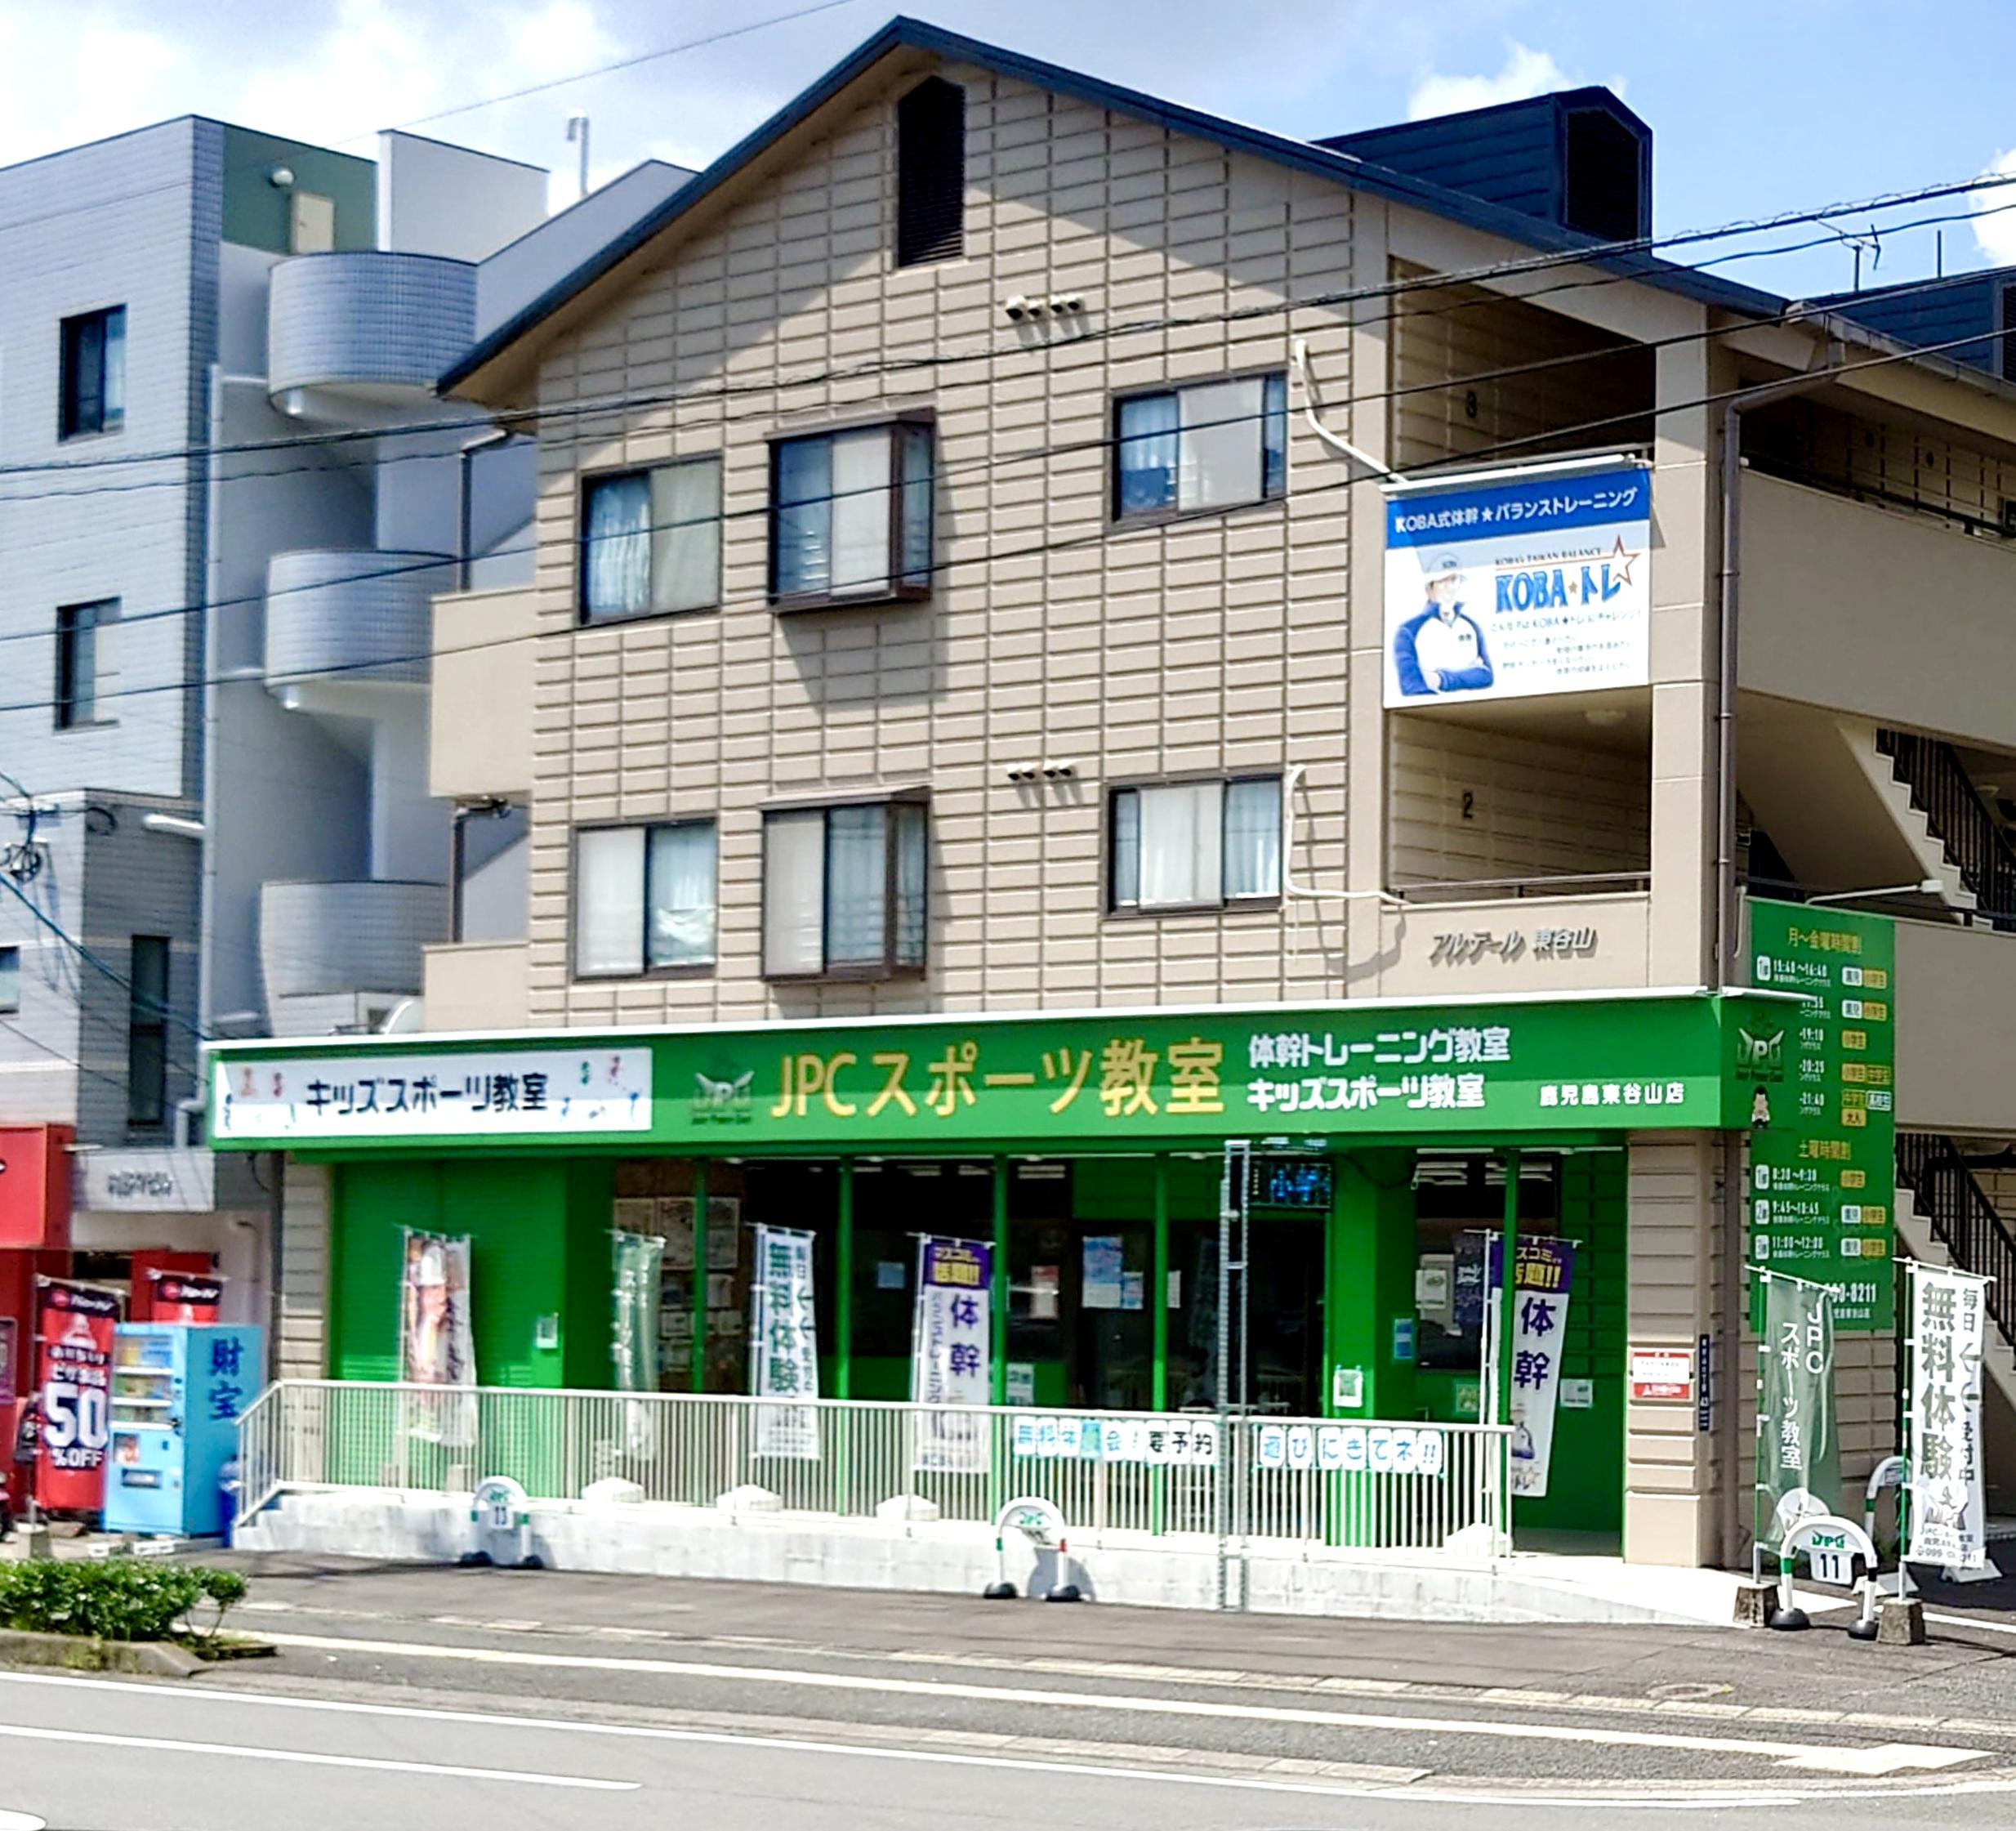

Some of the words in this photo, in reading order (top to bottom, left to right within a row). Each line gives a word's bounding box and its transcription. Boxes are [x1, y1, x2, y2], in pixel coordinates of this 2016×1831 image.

[1462, 791, 1473, 819] 2
[1249, 1027, 1510, 1069] 体幹トレーニング教室
[306, 1072, 548, 1116] キッズスポーツ教室
[771, 1036, 1224, 1118] JPCスポーツ教室
[1247, 1074, 1485, 1113] キッズスポーツ教室
[1540, 1082, 1684, 1107] 鹿児島東谷山店
[949, 1293, 982, 1379] 体幹
[1514, 1288, 1556, 1390] 体幹
[1806, 1302, 1823, 1374] JPC
[209, 1337, 244, 1420] 財宝
[1780, 1323, 1803, 1470] スポーツ教室
[1921, 1282, 1956, 1480] 無料体験
[43, 1381, 108, 1449] 50
[1148, 1431, 1213, 1455] 要予約
[51, 1447, 103, 1467] %OFF
[1820, 1553, 1839, 1579] 11
